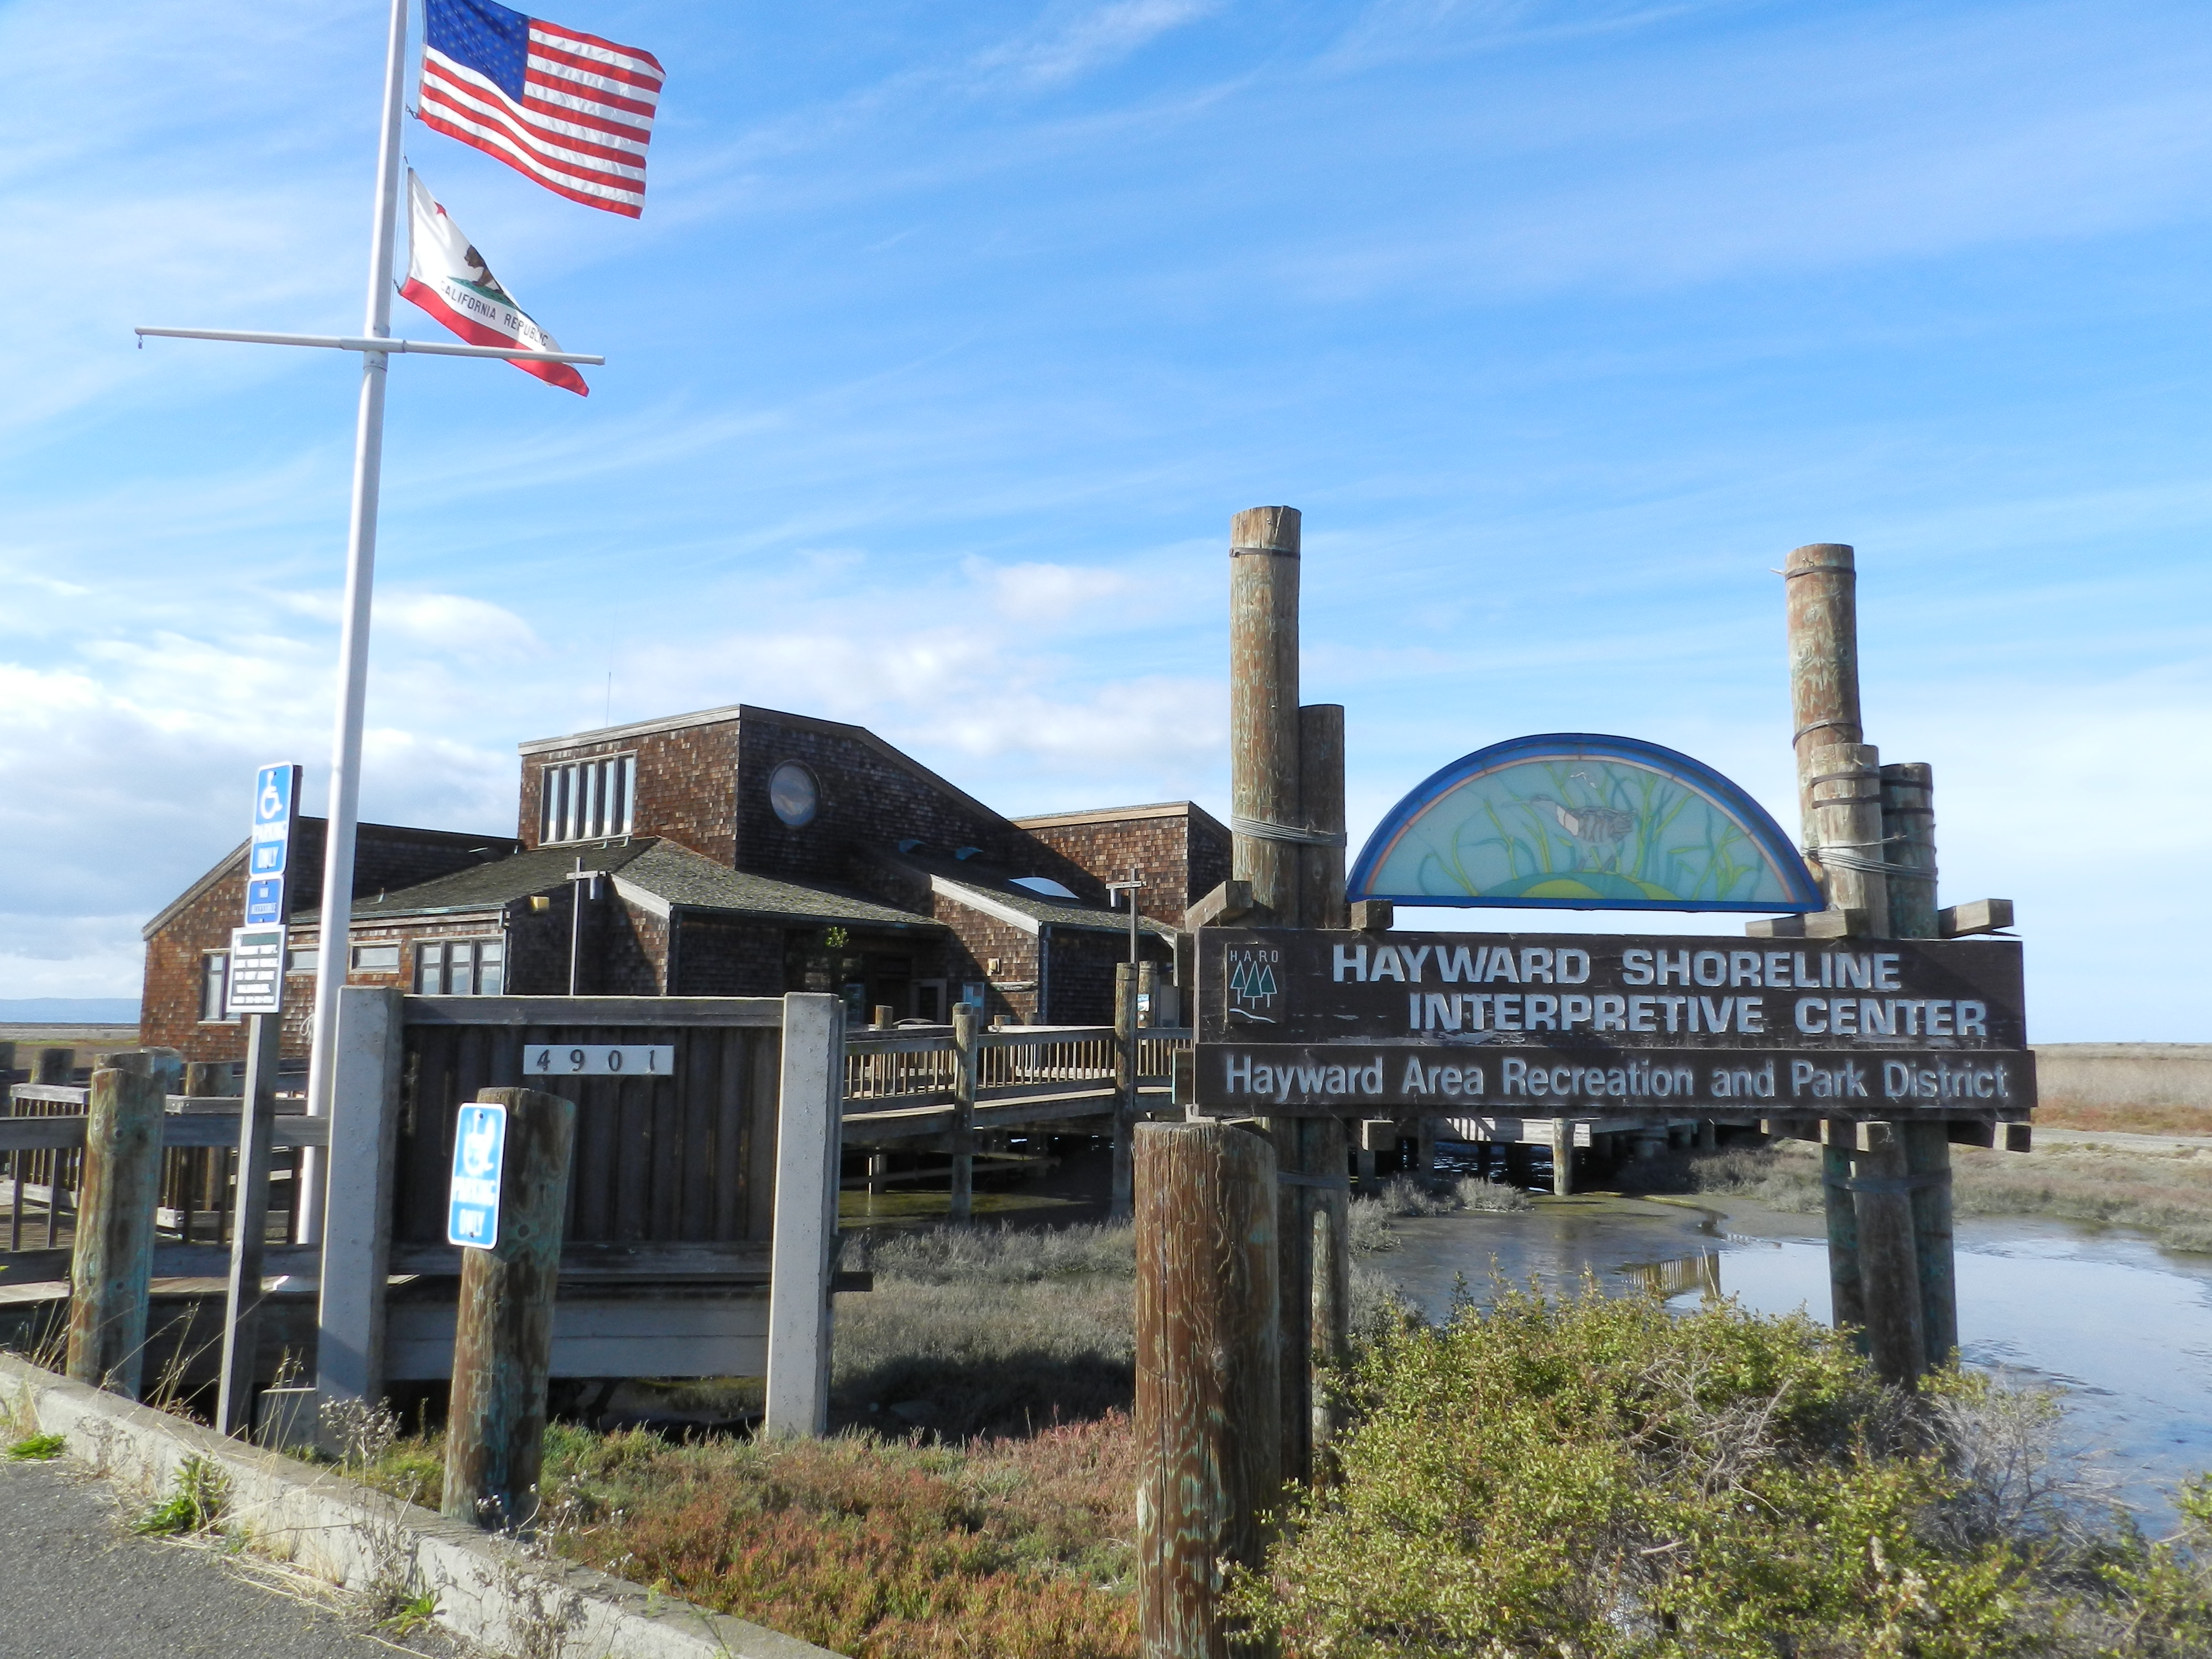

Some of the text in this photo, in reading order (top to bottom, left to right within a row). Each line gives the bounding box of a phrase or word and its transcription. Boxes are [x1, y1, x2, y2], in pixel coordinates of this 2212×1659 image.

[441, 280, 548, 346] CALIFORNIA REPUBLIC
[253, 820, 287, 846] PARKING
[257, 846, 279, 869] ONLY
[1230, 950, 1279, 962] HARD
[1333, 945, 1901, 989] HAYWARD SHORELINE
[1410, 993, 1986, 1036] INTERPRETIVE CENTER
[536, 1048, 655, 1072] 4901
[1226, 1055, 2008, 1103] Hayward Area Recreation and Park District
[453, 1176, 496, 1207] PARKING
[459, 1208, 486, 1237] ONLY
